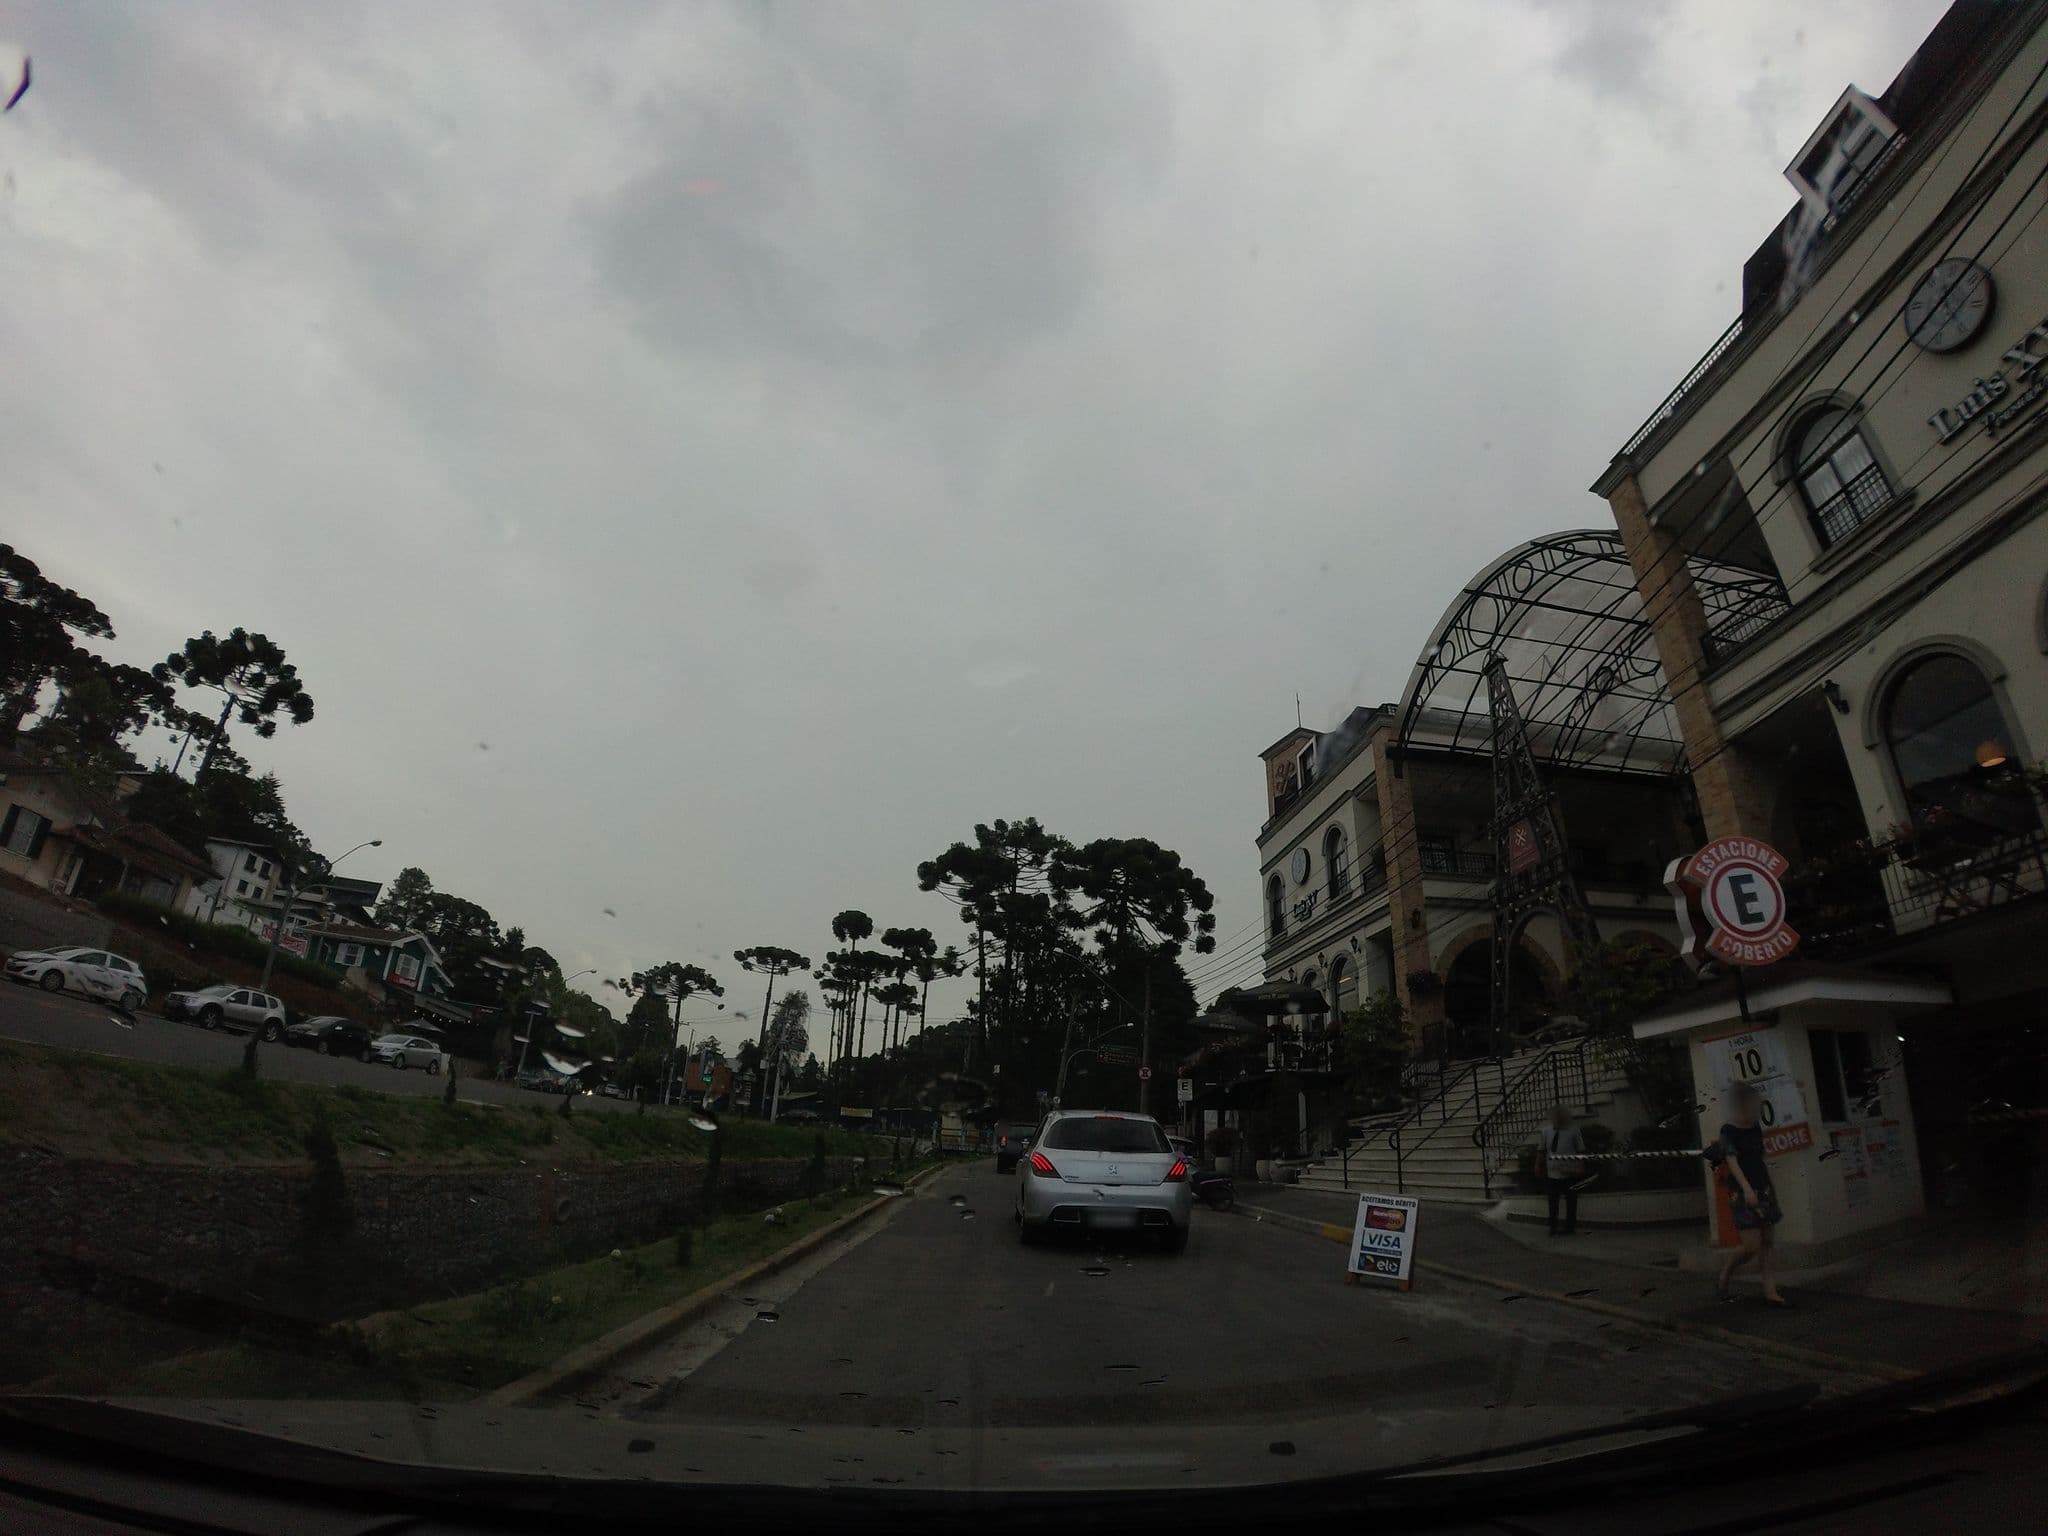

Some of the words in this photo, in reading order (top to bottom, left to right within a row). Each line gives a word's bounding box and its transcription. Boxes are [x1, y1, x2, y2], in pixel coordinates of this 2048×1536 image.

[1927, 371, 2009, 445] Luis
[1695, 840, 1780, 877] ESTACIONE
[1728, 873, 1765, 925] E
[1720, 930, 1792, 961] COBERTO
[1734, 1048, 1762, 1079] 10
[1181, 1081, 1189, 1091] E
[1368, 1233, 1401, 1249] VISA
[1376, 1260, 1399, 1272] elo
